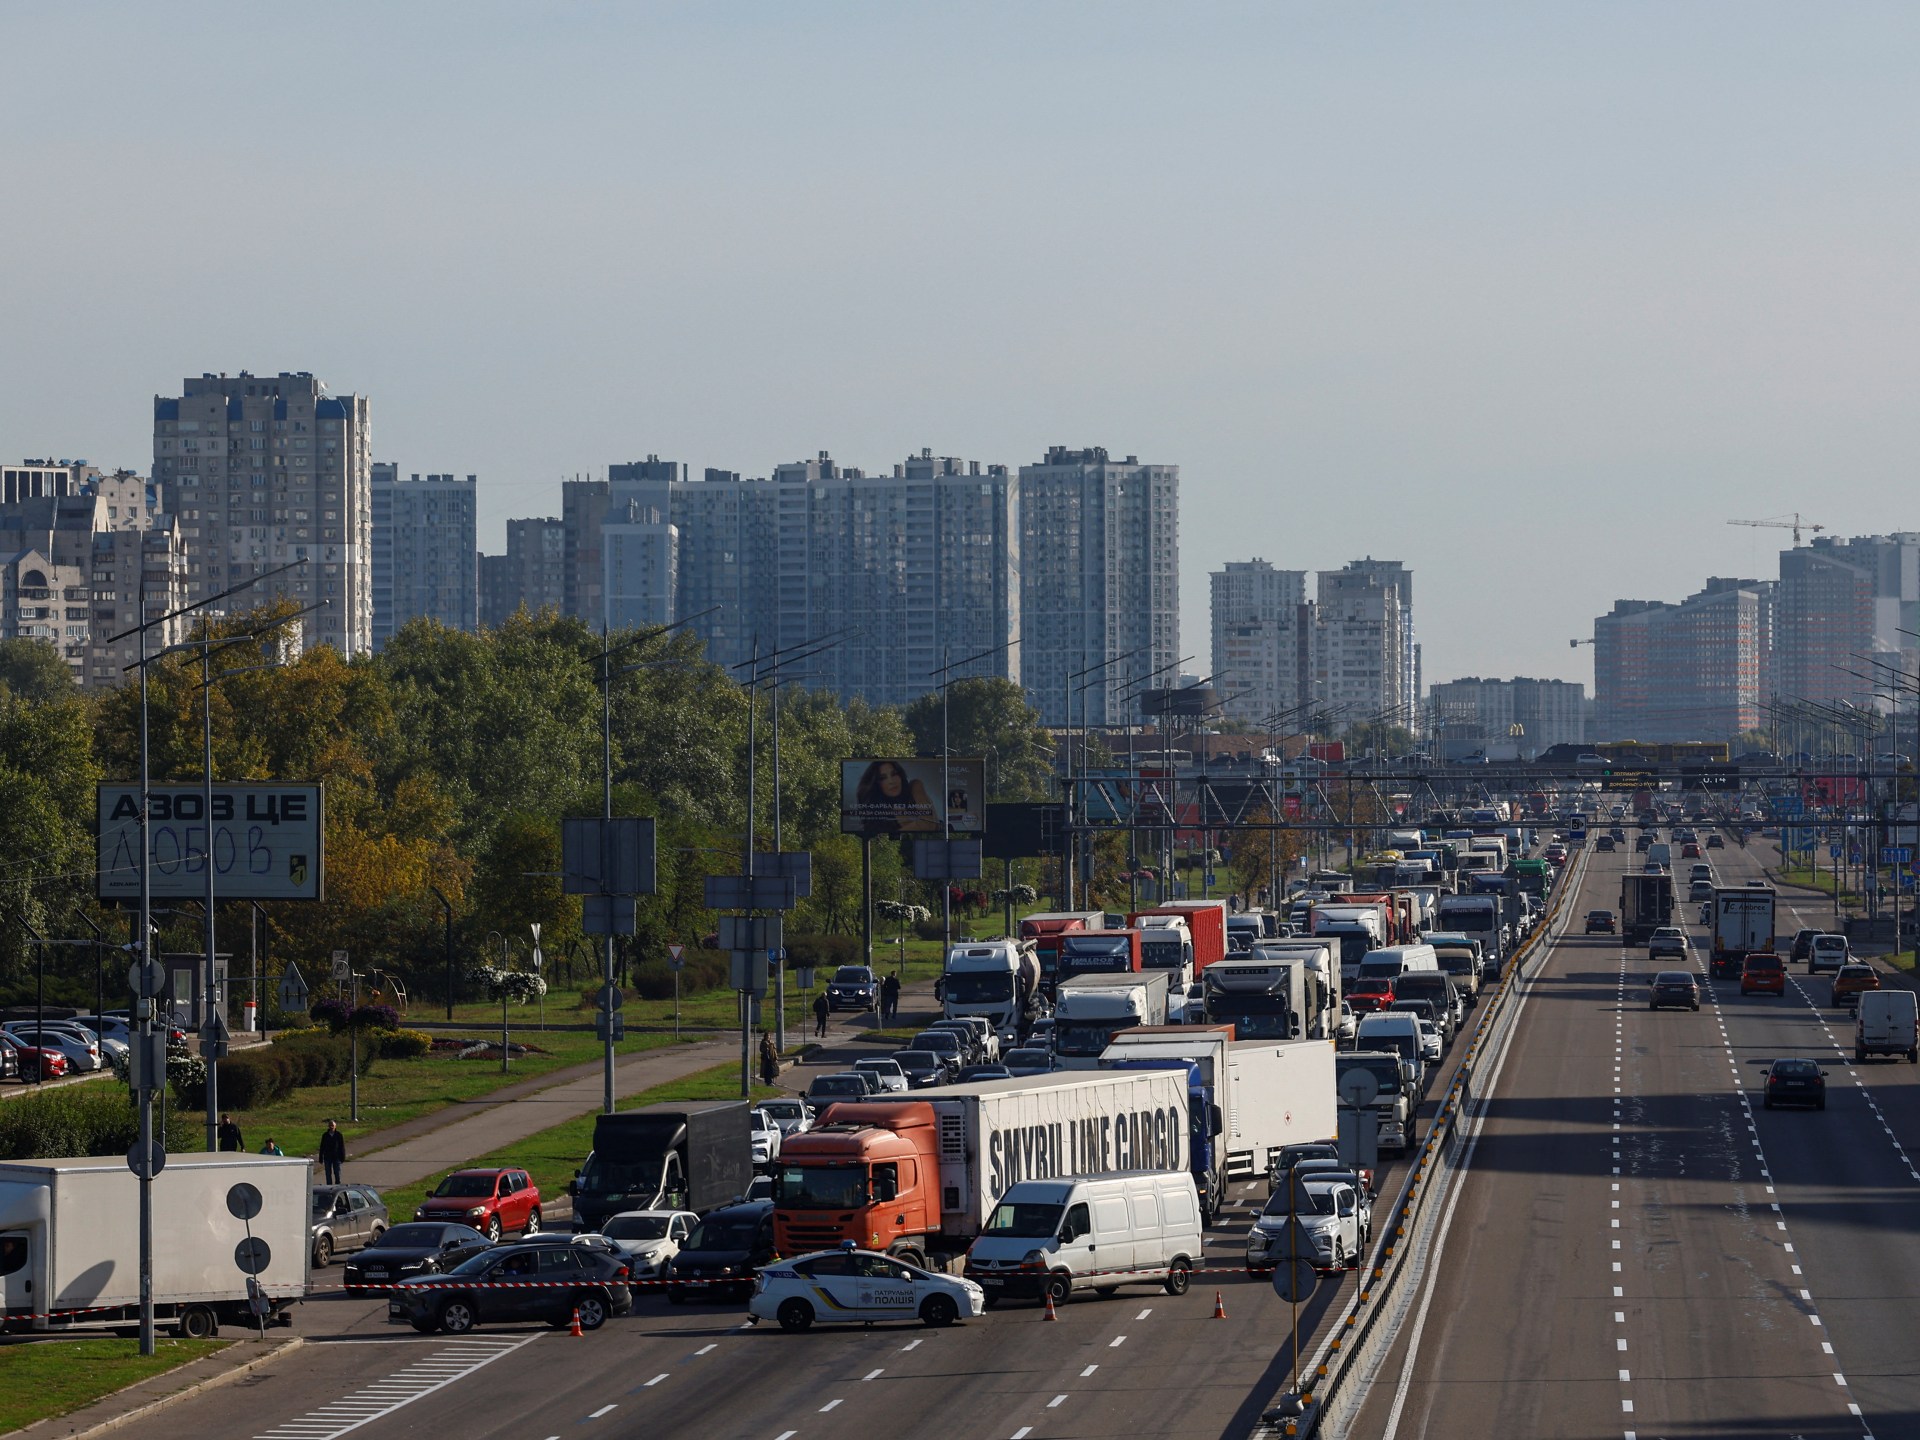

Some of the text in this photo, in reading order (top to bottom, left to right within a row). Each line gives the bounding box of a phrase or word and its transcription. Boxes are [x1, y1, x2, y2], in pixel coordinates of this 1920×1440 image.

[110, 794, 307, 826] АЗОВ ЦЕ
[1070, 957, 1115, 966] WALDOR
[1115, 1106, 1180, 1170] CARGO
[874, 1296, 915, 1305] ПОЛІЦІЯ
